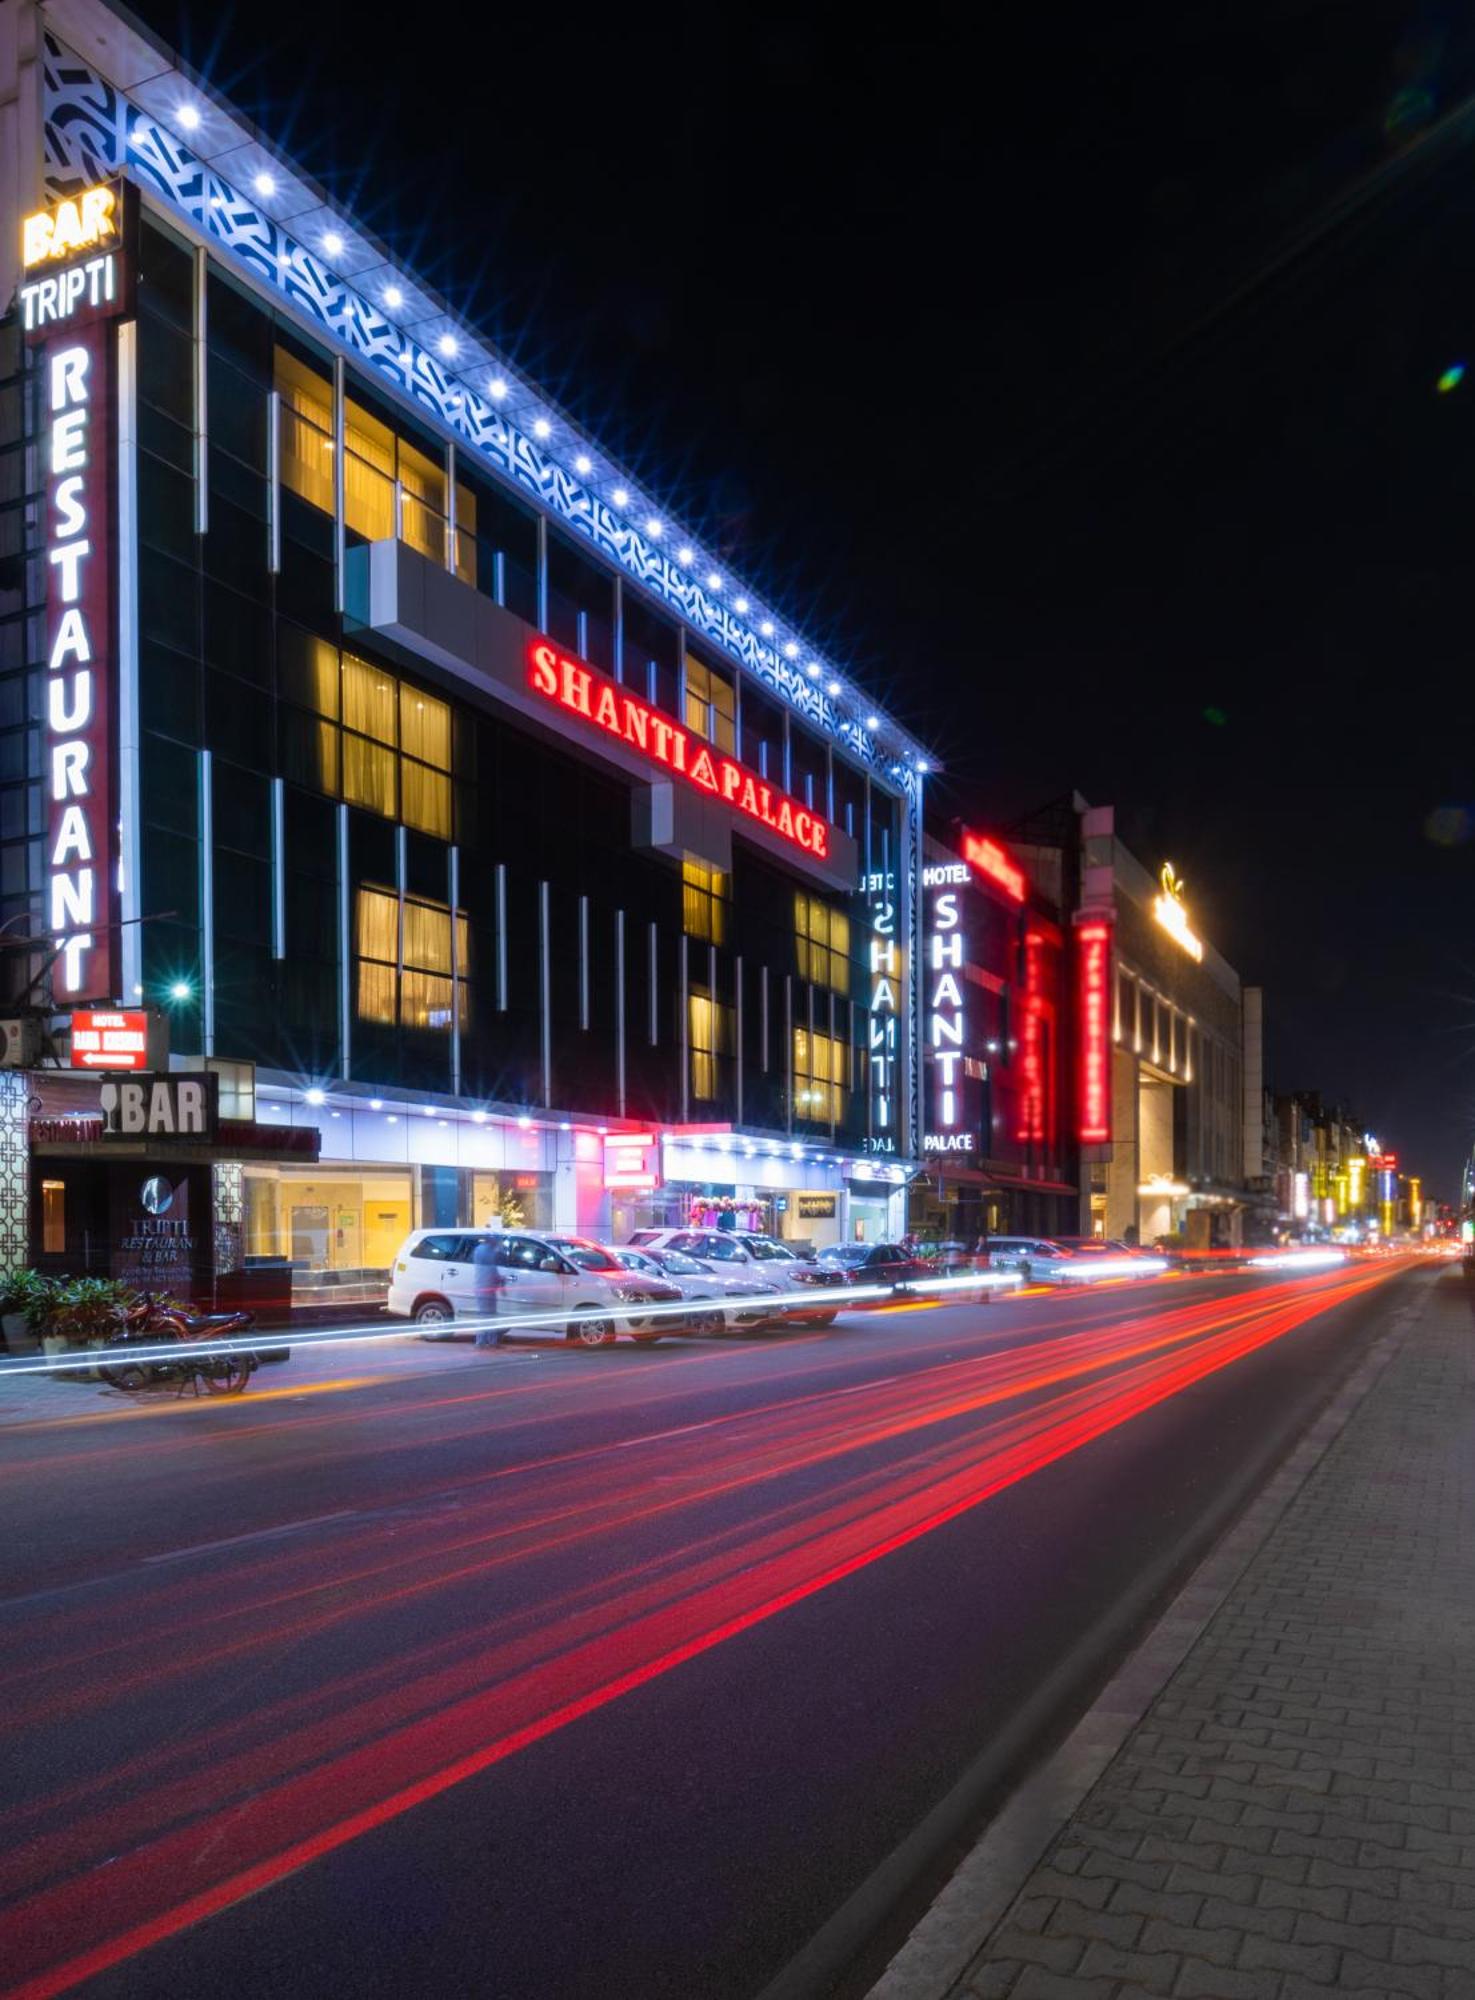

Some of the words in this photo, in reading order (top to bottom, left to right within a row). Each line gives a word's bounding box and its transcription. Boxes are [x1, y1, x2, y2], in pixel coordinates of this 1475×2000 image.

[24, 187, 115, 267] BAR
[20, 254, 114, 330] TRIPTI
[48, 346, 94, 992] RESTAURANT
[534, 646, 686, 770] SHANTI
[722, 762, 826, 857] PALACE
[923, 864, 971, 886] HOTEL
[932, 894, 963, 1125] SHANTI
[121, 1081, 206, 1133] BAR
[924, 1135, 972, 1151] PALACE
